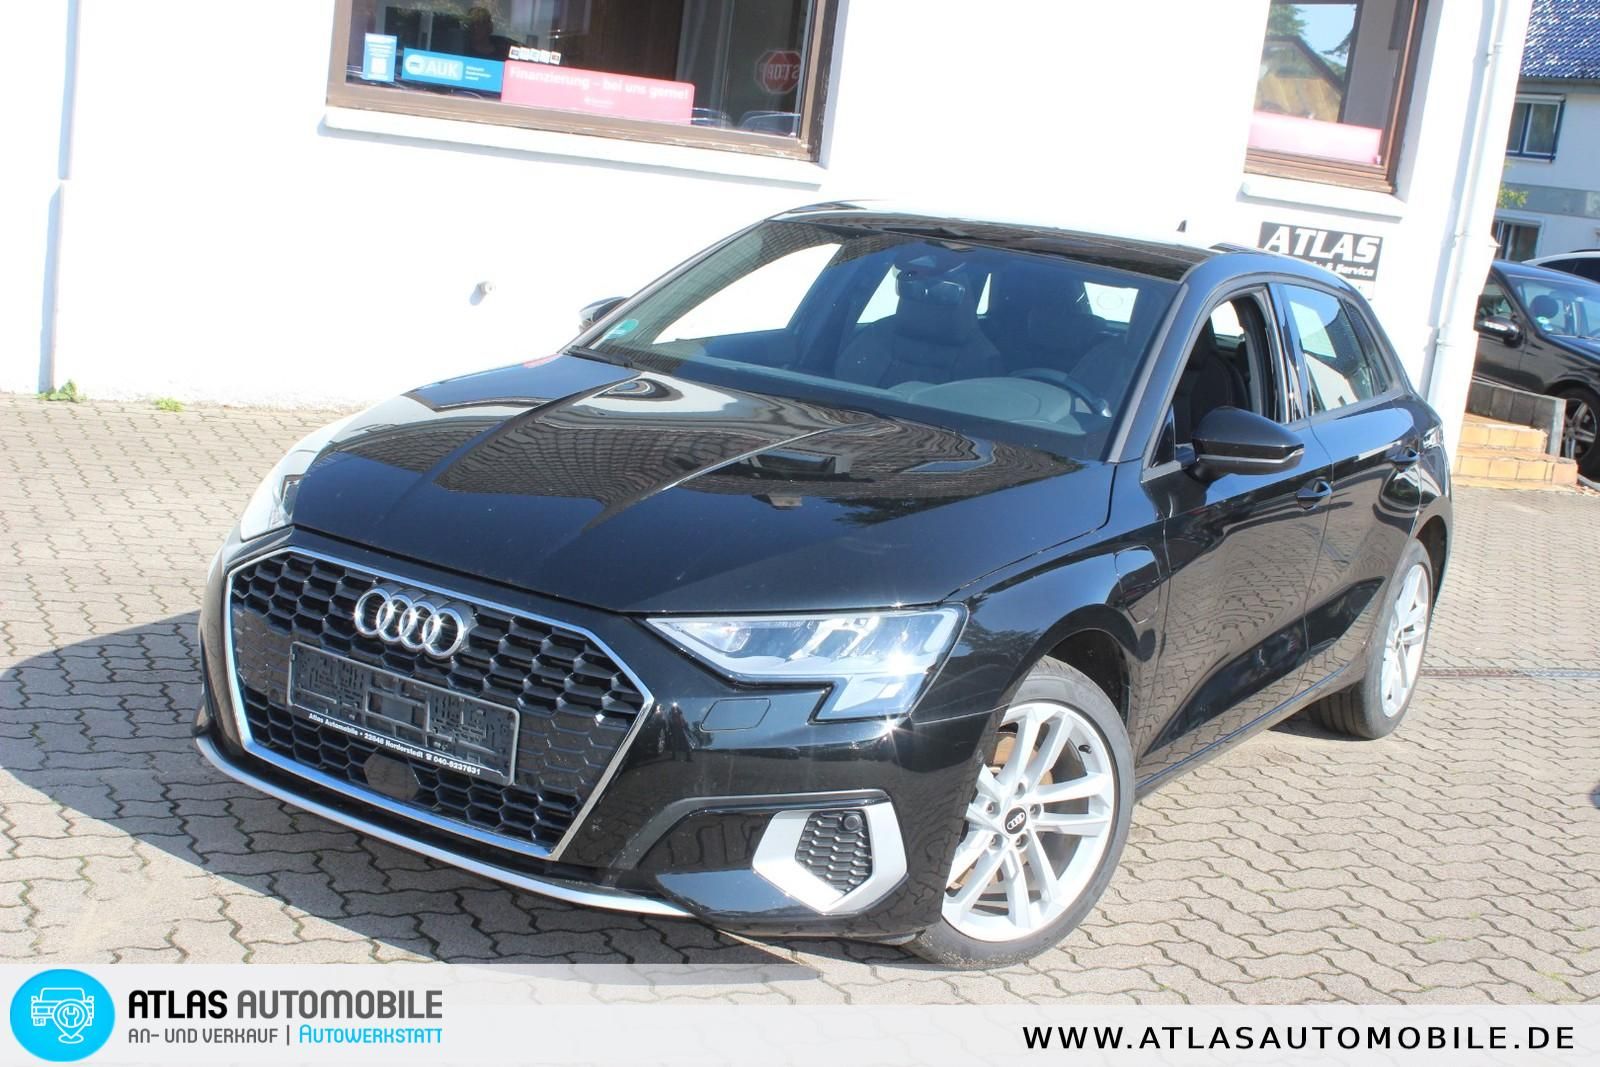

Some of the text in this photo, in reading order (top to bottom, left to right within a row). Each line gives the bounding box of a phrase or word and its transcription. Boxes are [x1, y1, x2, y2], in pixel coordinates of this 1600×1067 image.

[423, 60, 459, 79] AUK
[510, 66, 590, 90] Finanzierung
[602, 78, 624, 93] bei
[624, 83, 647, 95] uns
[649, 85, 689, 101] gerne!
[1262, 225, 1381, 263] ATLAS
[1336, 263, 1376, 277] Service
[308, 712, 324, 724] Atlas
[325, 718, 359, 736] Automobile
[385, 739, 424, 759] Norderstedt
